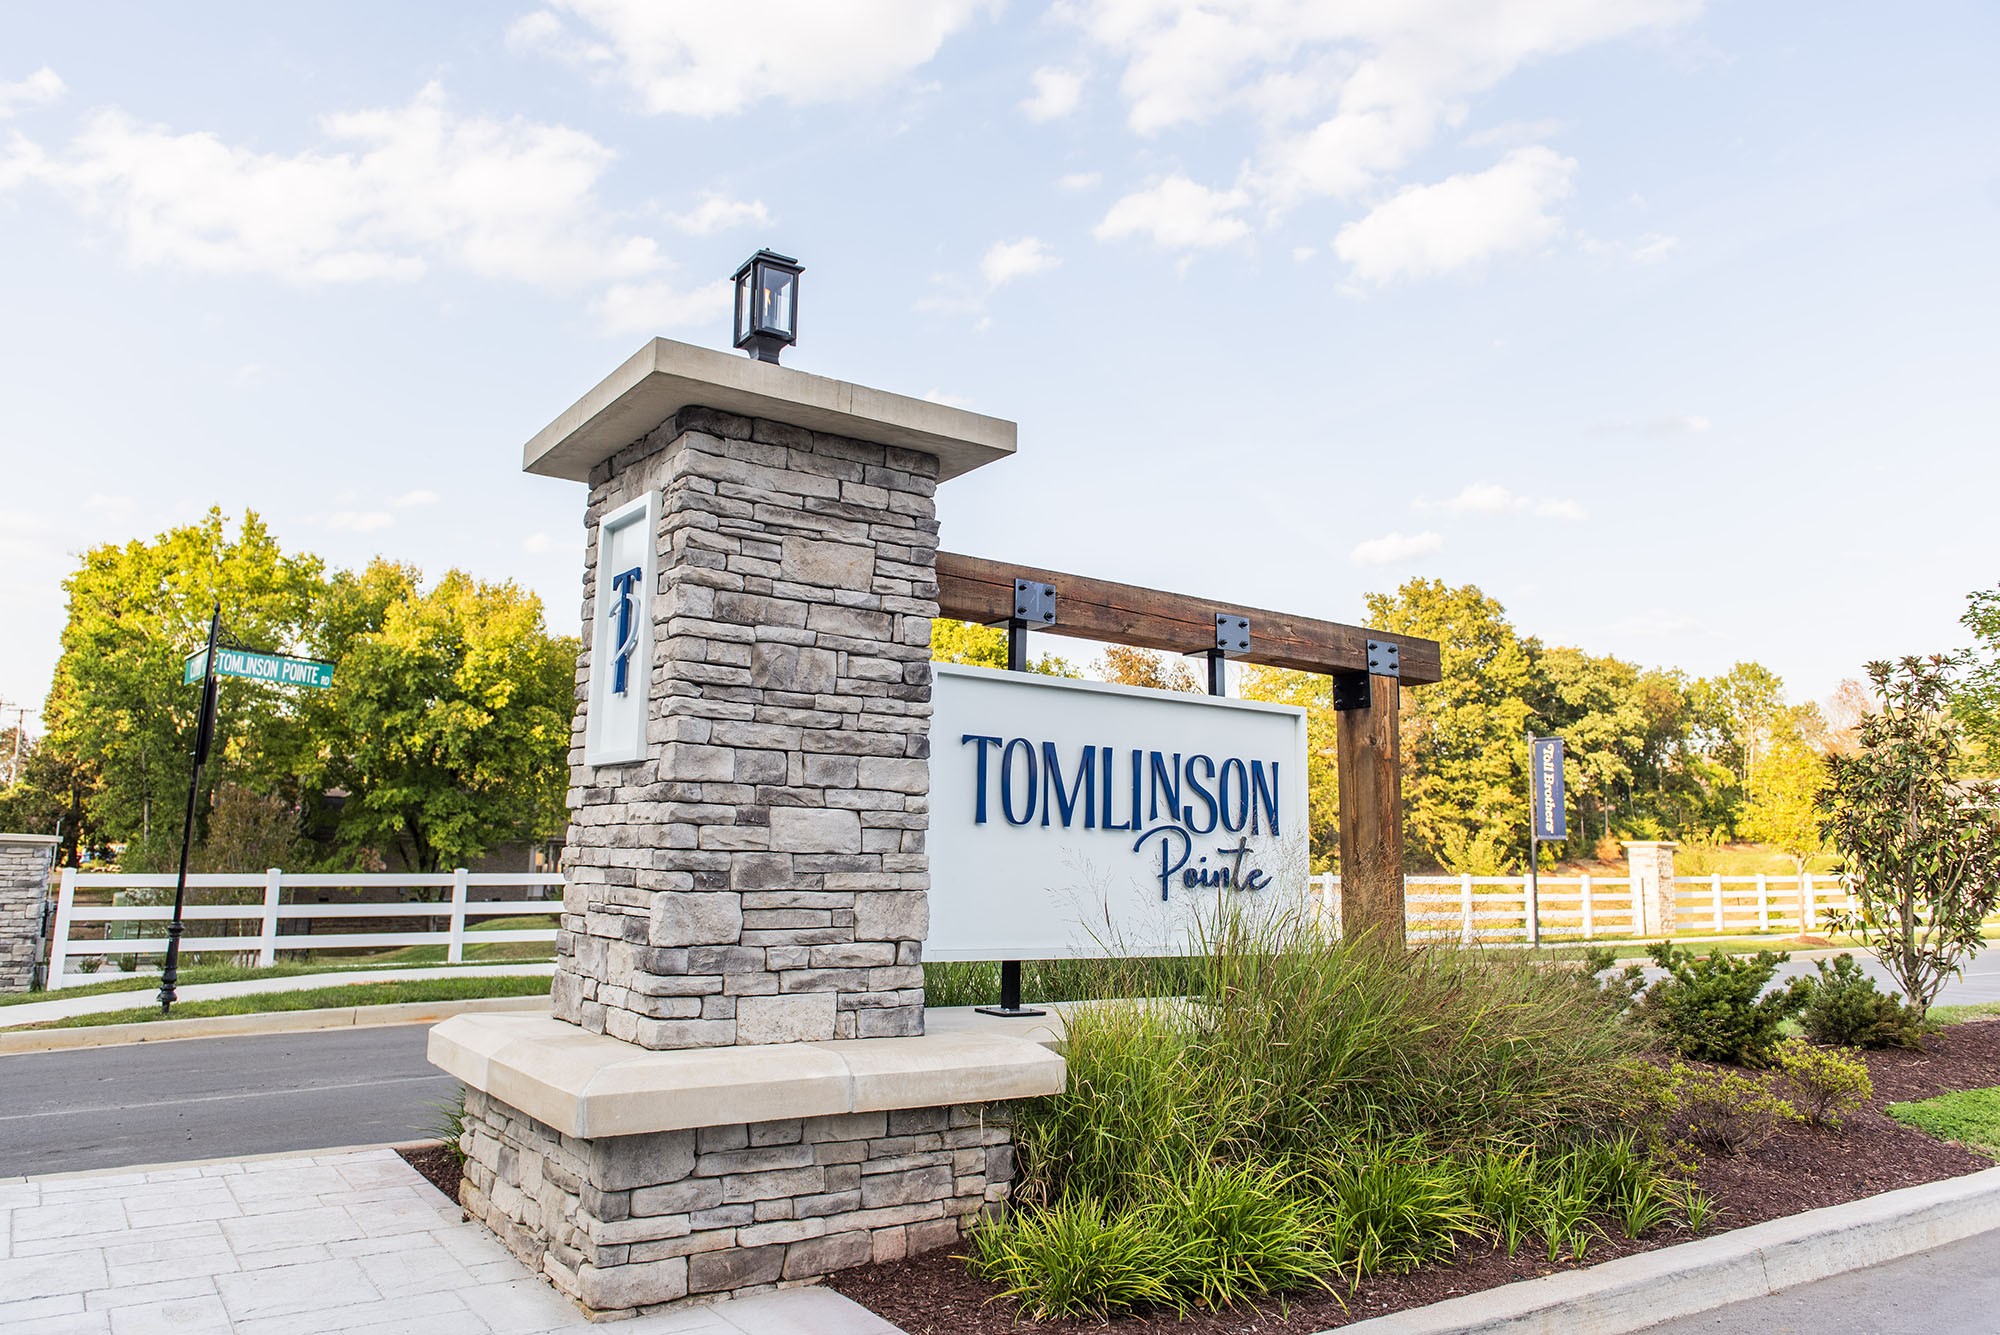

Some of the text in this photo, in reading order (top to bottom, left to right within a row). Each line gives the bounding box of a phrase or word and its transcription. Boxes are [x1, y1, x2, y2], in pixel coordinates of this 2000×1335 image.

[218, 653, 279, 678] TOMLINSON
[281, 661, 320, 684] POINTE
[320, 675, 330, 686] RD
[962, 734, 1280, 836] TOMLINSON
[1543, 743, 1556, 834] Toll Brothers
[1133, 825, 1273, 901] Pointe
